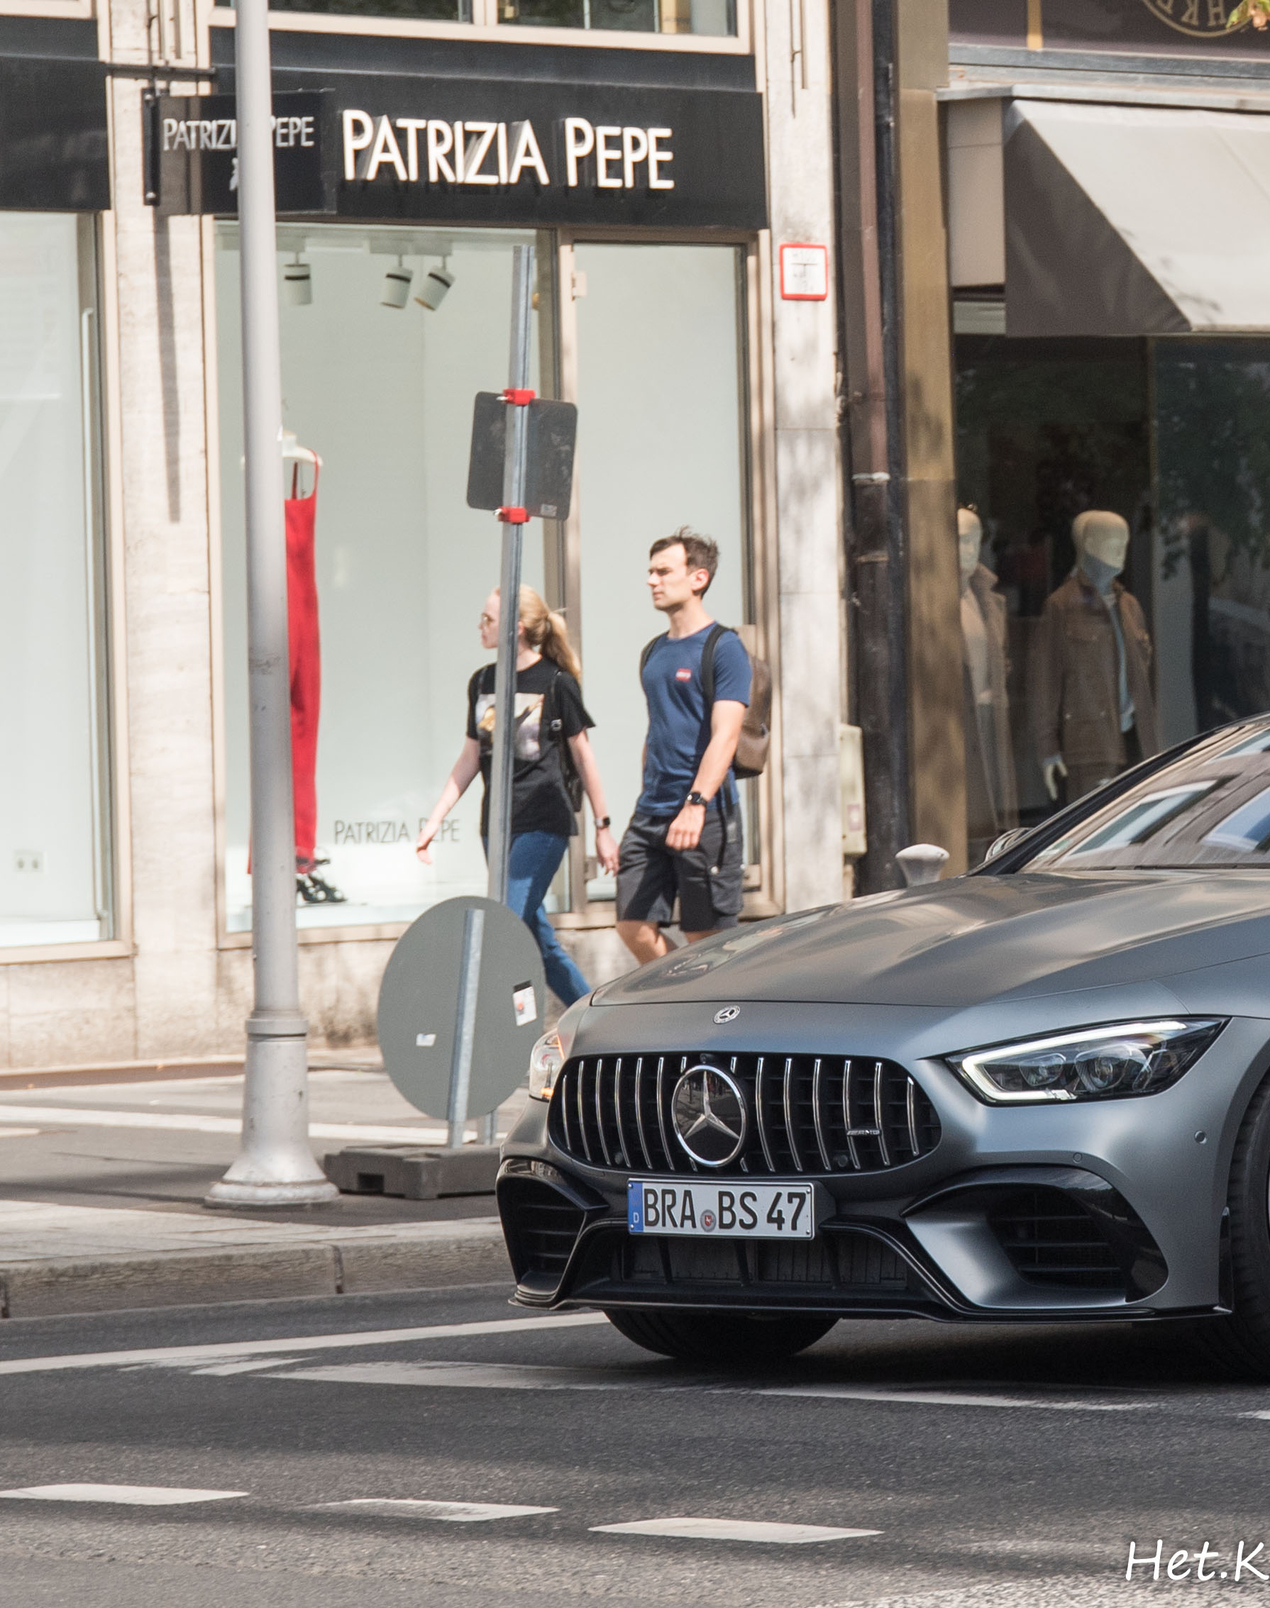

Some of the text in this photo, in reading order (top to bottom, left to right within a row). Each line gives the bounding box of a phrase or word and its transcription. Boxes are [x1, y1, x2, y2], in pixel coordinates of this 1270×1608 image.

[163, 118, 238, 151] PATRIZI
[342, 108, 675, 190] PATRIZIA PEPE
[334, 817, 461, 844] PATRIZIA PPE
[632, 1188, 807, 1231] D BRA BS 47
